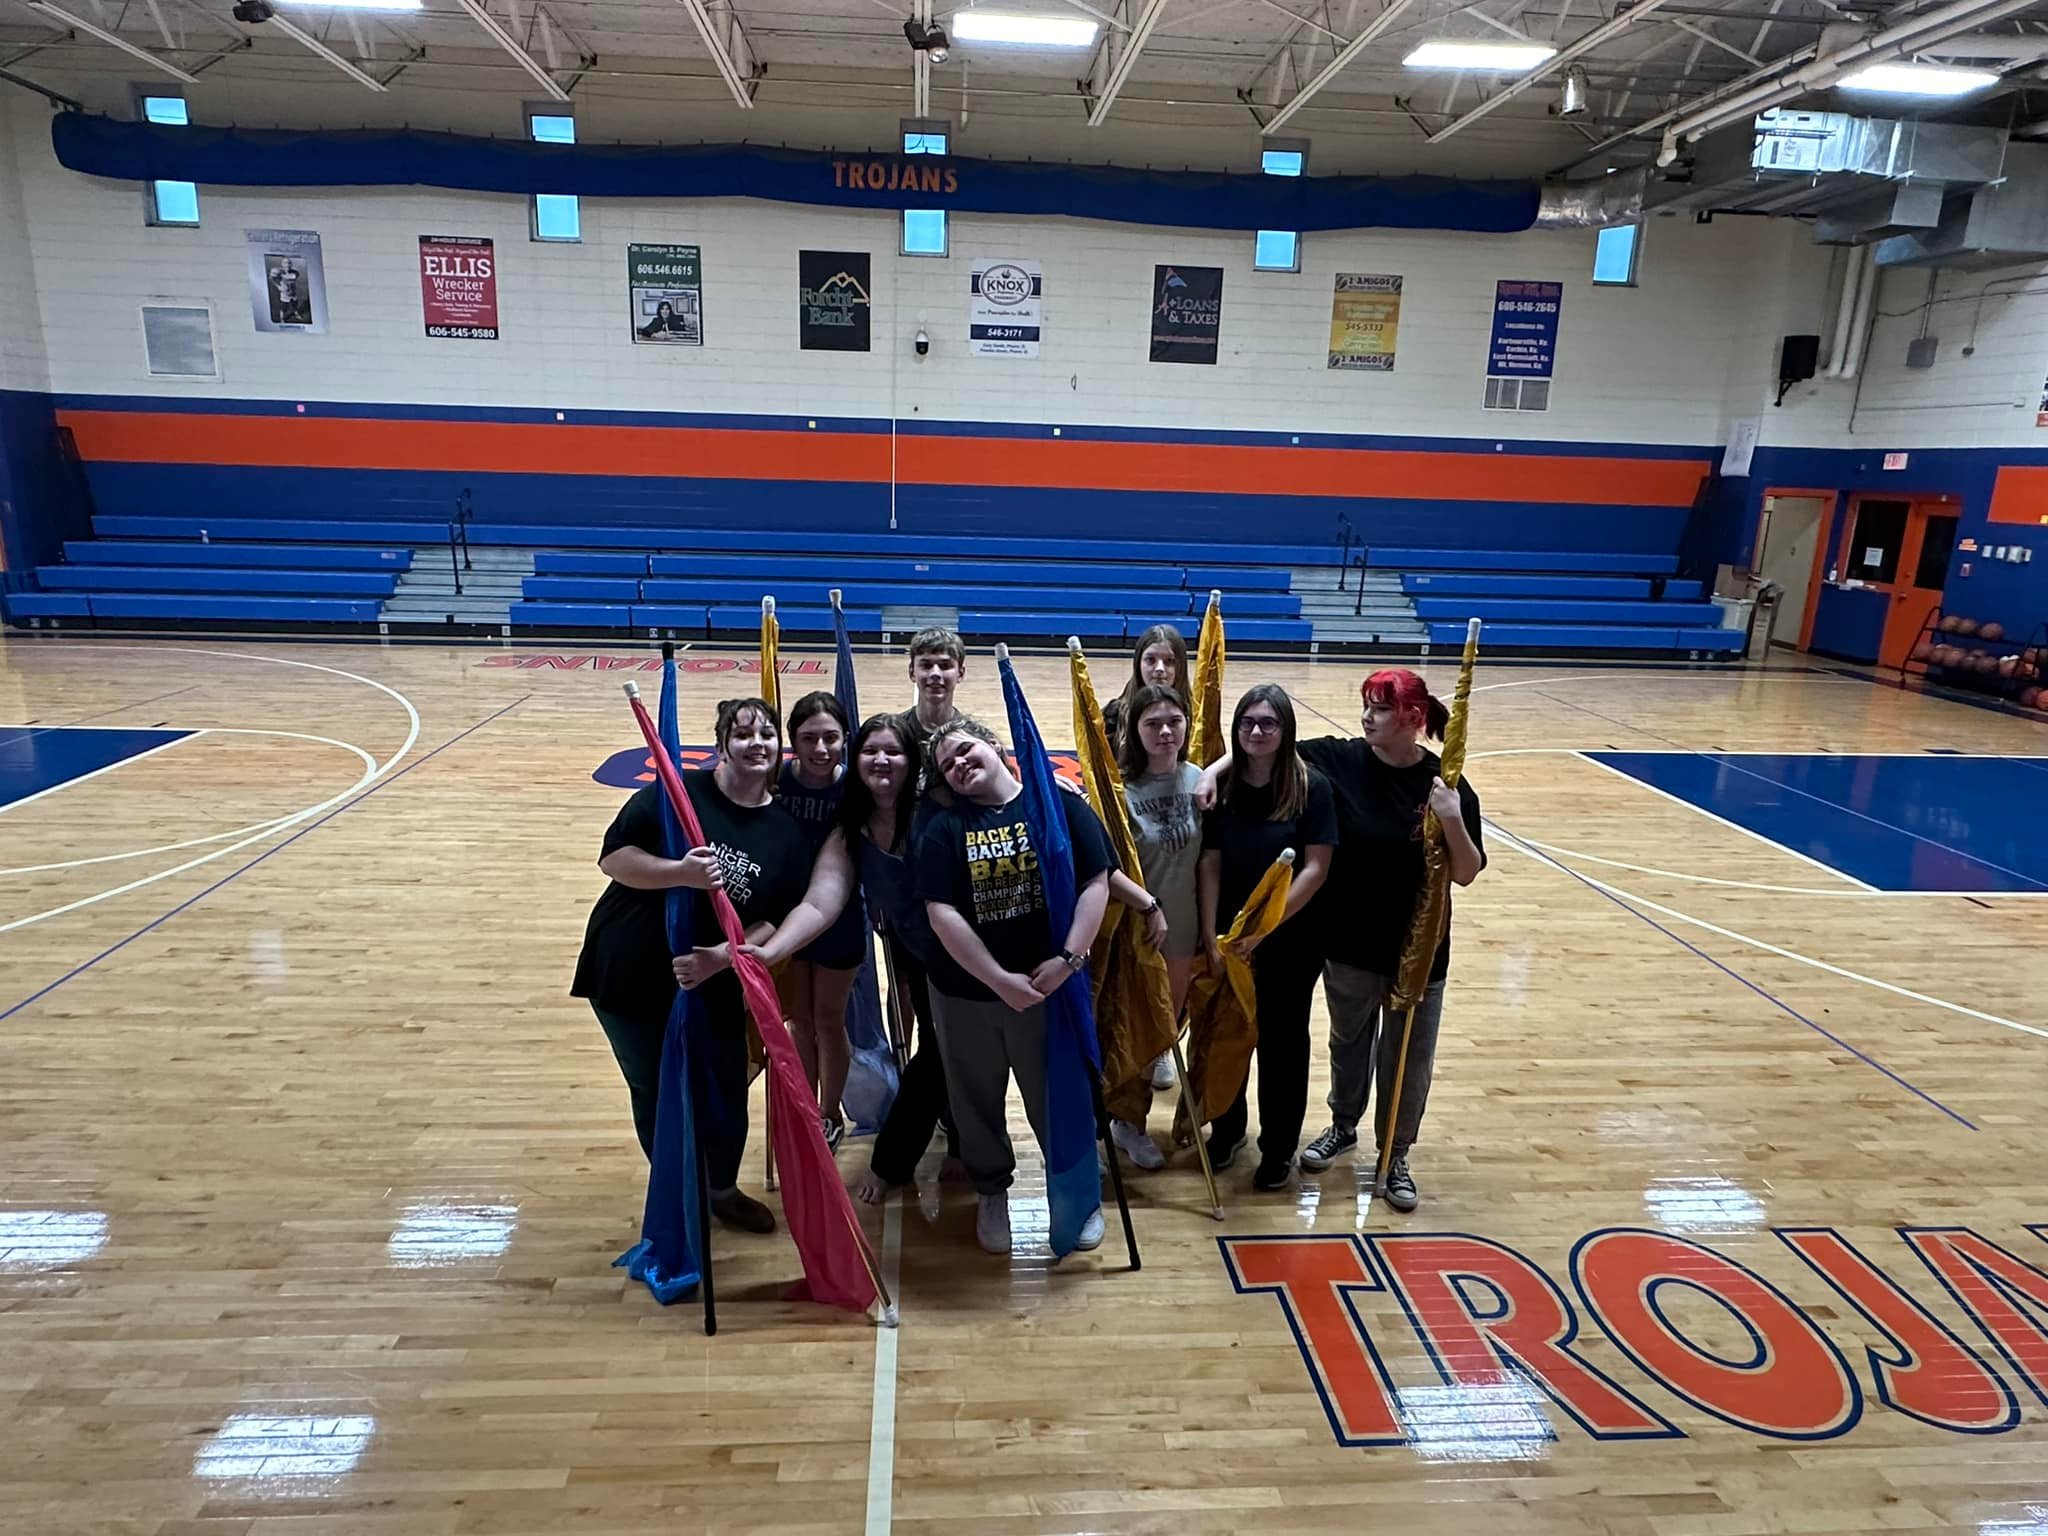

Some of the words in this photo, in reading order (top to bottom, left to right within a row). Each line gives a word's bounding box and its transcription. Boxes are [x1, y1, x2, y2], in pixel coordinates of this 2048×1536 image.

[832, 161, 958, 193] TROJANS
[424, 256, 491, 278] ELLIS
[637, 264, 693, 276] 606.546.6615
[432, 277, 485, 291] Wrecker
[986, 279, 1025, 294] KNOX
[1356, 277, 1390, 286] AMIGOS
[435, 288, 483, 302] Service
[800, 287, 855, 308] Forcht
[808, 306, 856, 327] Bank
[1168, 310, 1180, 324] &
[429, 326, 495, 338] 606-545-9580
[1350, 355, 1383, 364] AMIGOS
[966, 826, 1013, 846] BACK
[1014, 822, 1027, 837] 2
[966, 841, 1016, 862] BACK
[1018, 836, 1030, 852] 2
[969, 851, 1038, 880] BAC
[972, 882, 1031, 903] CHAMPIONS
[1217, 1226, 2048, 1448] TROJA
